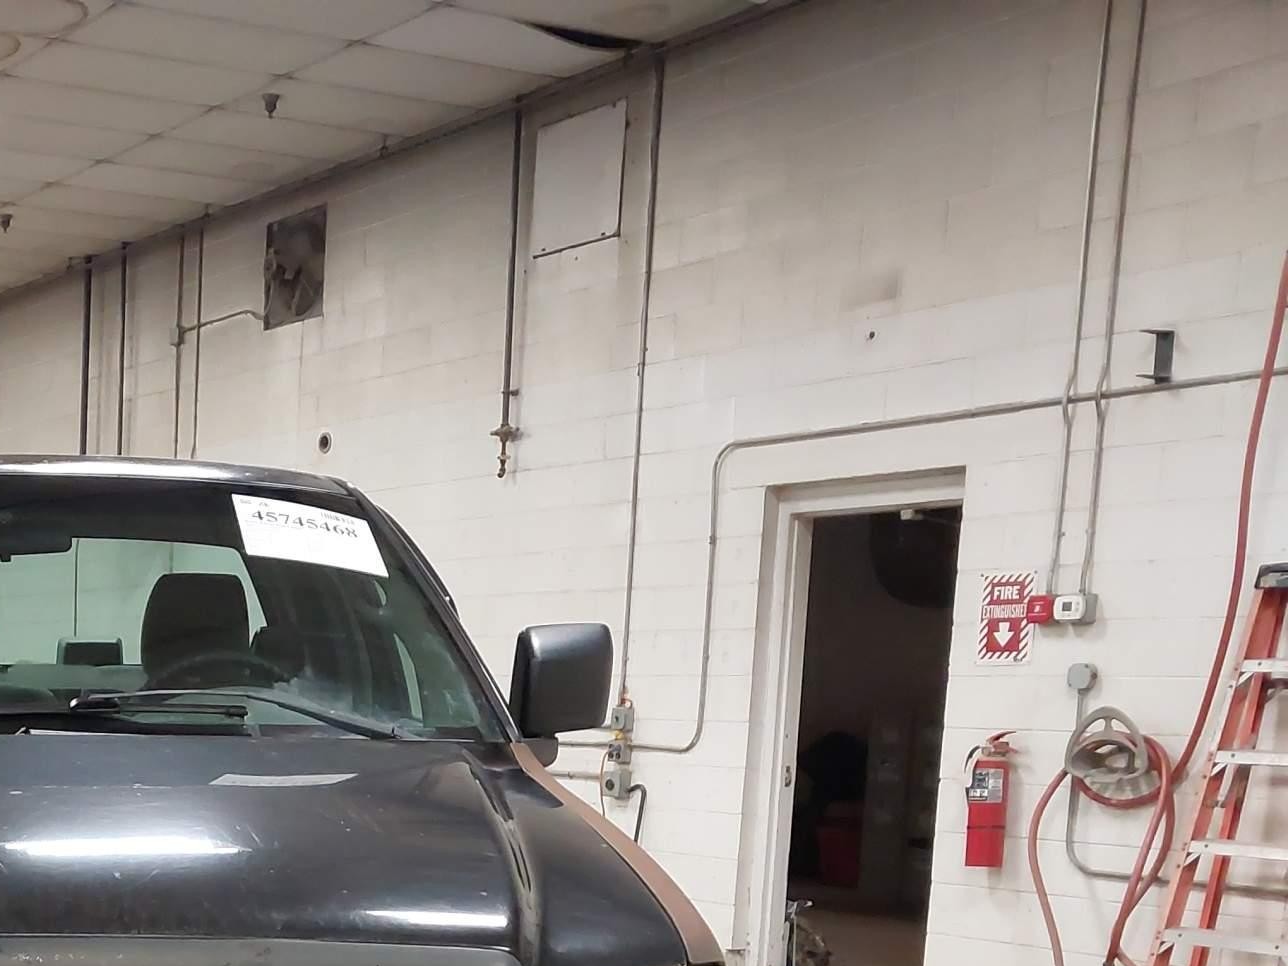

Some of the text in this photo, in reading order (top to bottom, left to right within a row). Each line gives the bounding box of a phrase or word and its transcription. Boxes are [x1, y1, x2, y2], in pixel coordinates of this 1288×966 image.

[252, 509, 358, 538] 45745468
[994, 585, 1021, 600] FIRE
[982, 604, 1028, 619] EXTINGUISHE
